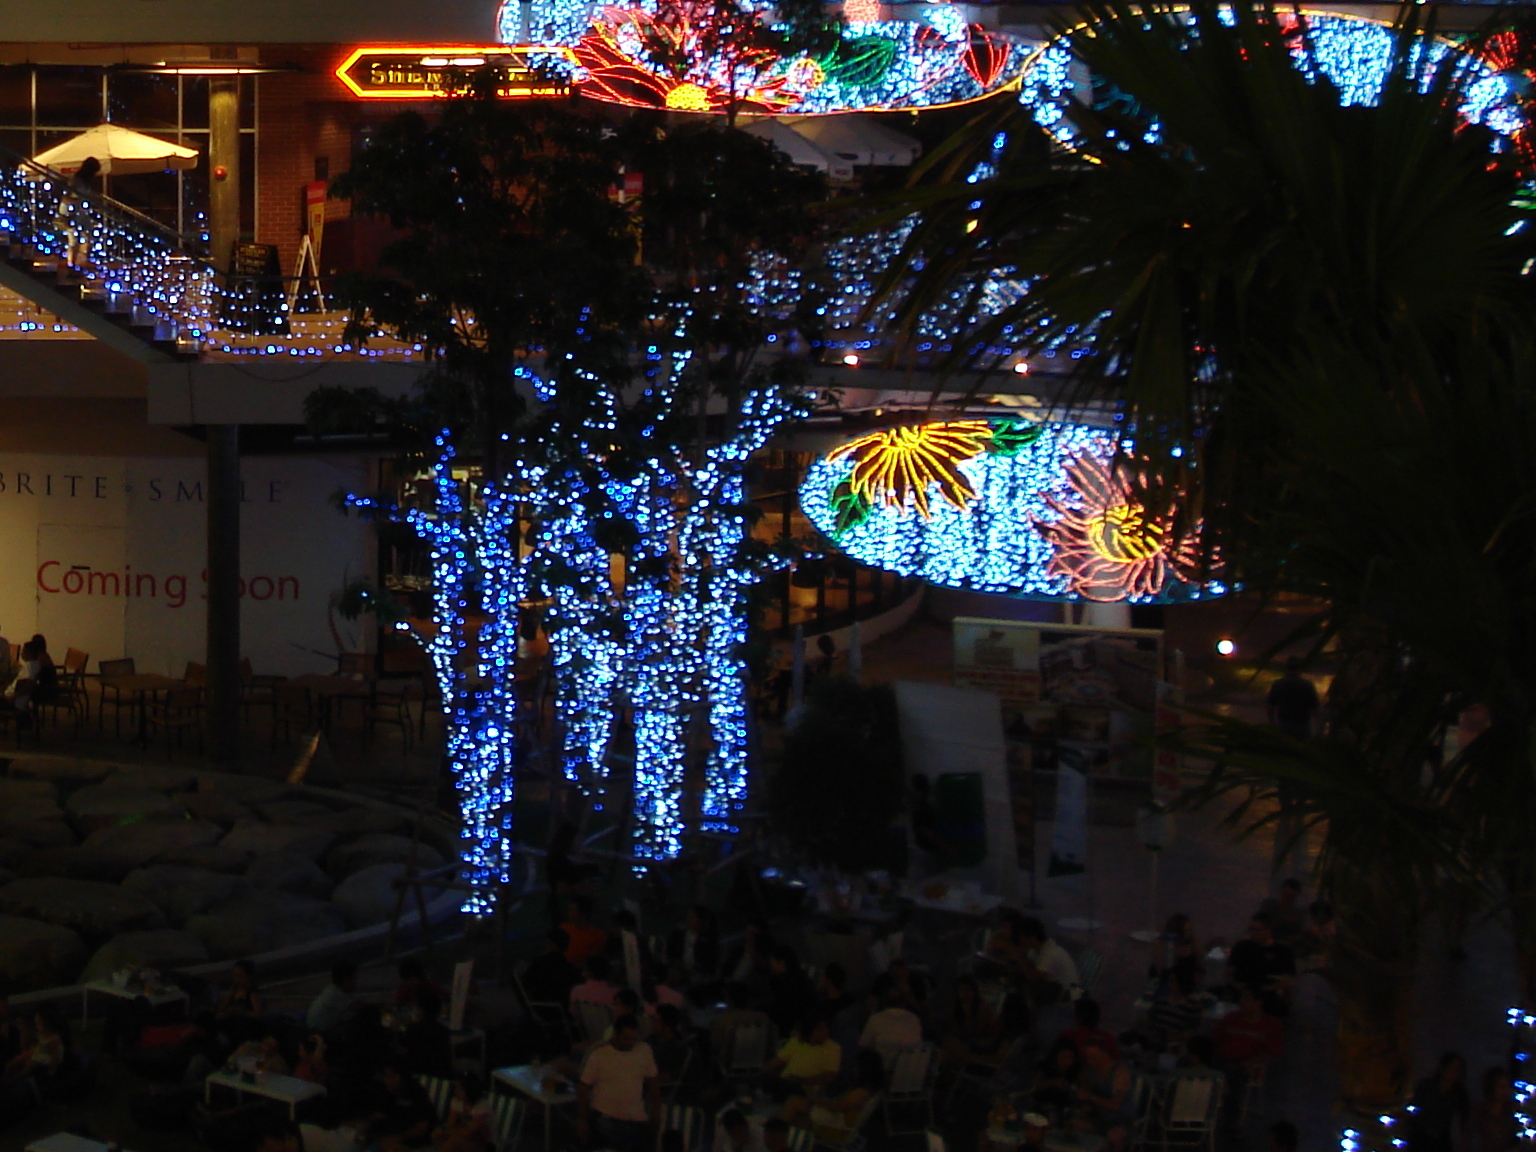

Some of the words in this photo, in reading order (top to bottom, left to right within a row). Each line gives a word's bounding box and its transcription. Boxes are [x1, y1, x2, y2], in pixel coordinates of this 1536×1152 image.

[149, 478, 283, 503] SMLE
[37, 560, 187, 608] Coming
[201, 568, 300, 600] on
